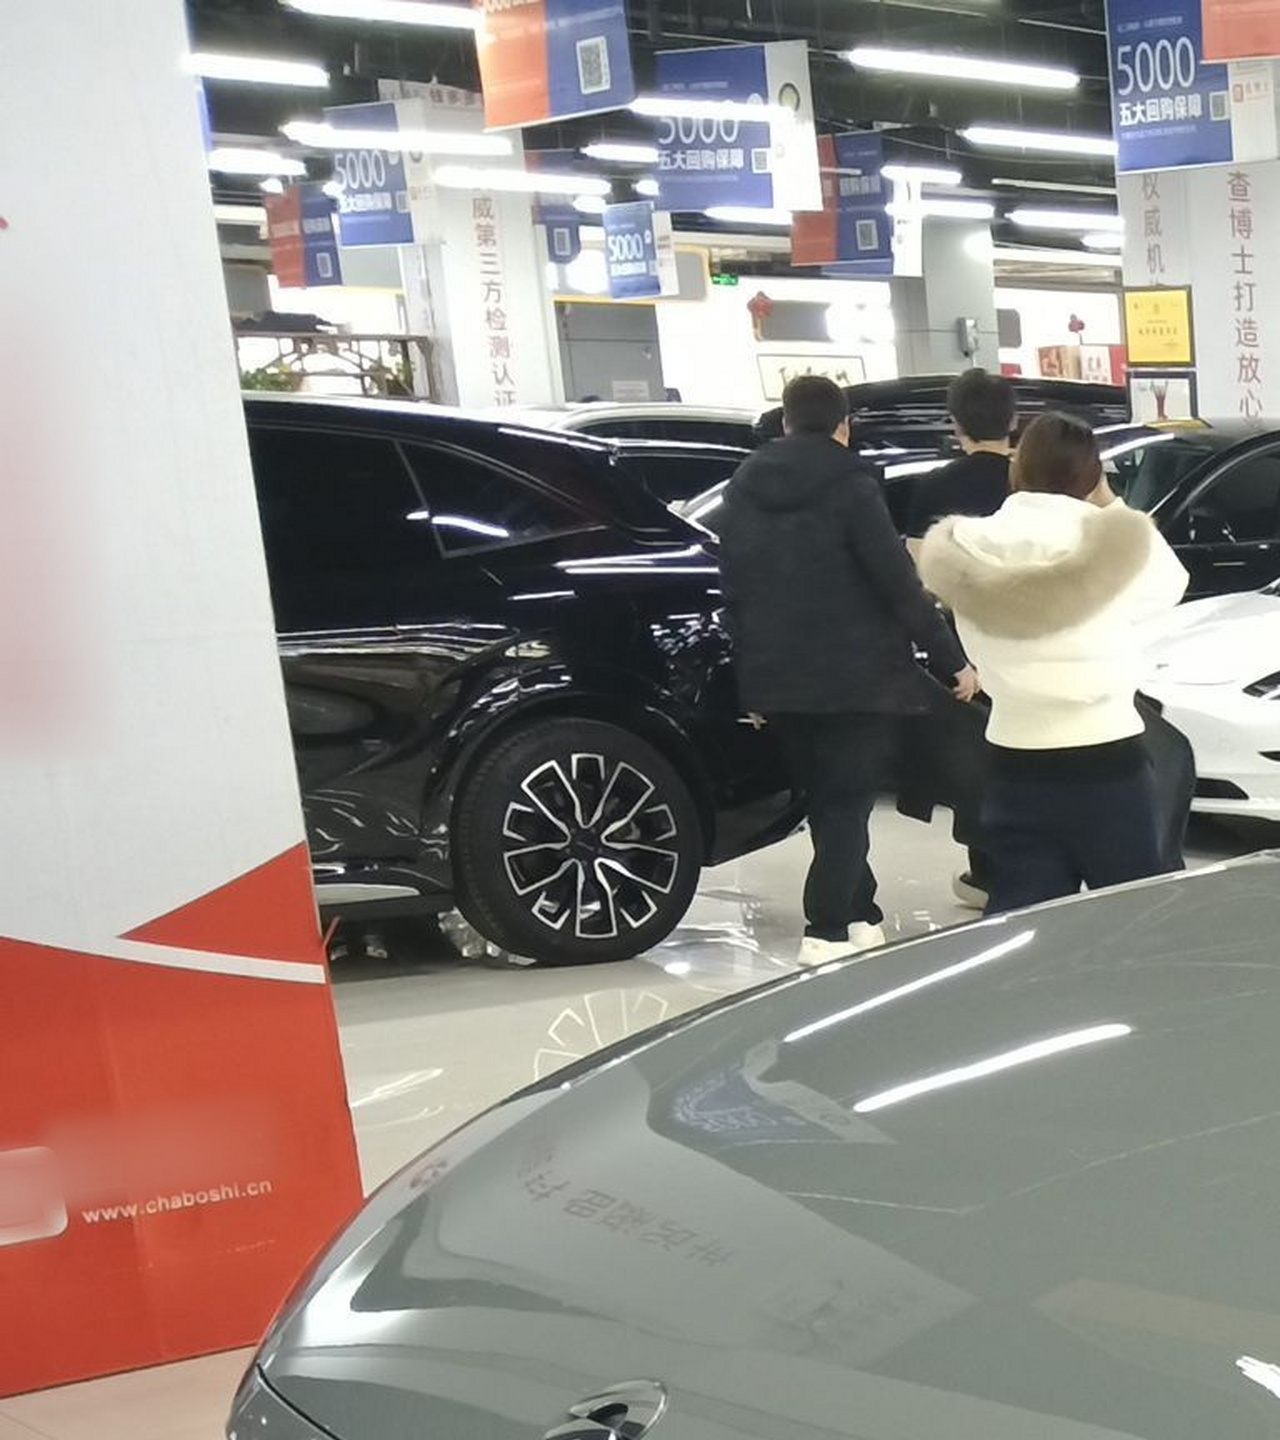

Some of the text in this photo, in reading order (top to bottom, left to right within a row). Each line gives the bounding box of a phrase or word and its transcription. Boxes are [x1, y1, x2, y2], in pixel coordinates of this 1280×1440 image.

[1117, 36, 1196, 96] 5000
[1119, 93, 1203, 126] 五大回购保障
[334, 149, 387, 190] 5000
[657, 149, 745, 171] 五大回购保障
[1141, 174, 1166, 284] 权威机
[1226, 170, 1263, 427] 查博士打造放心
[82, 1179, 272, 1224] www.chaboshi.cn
